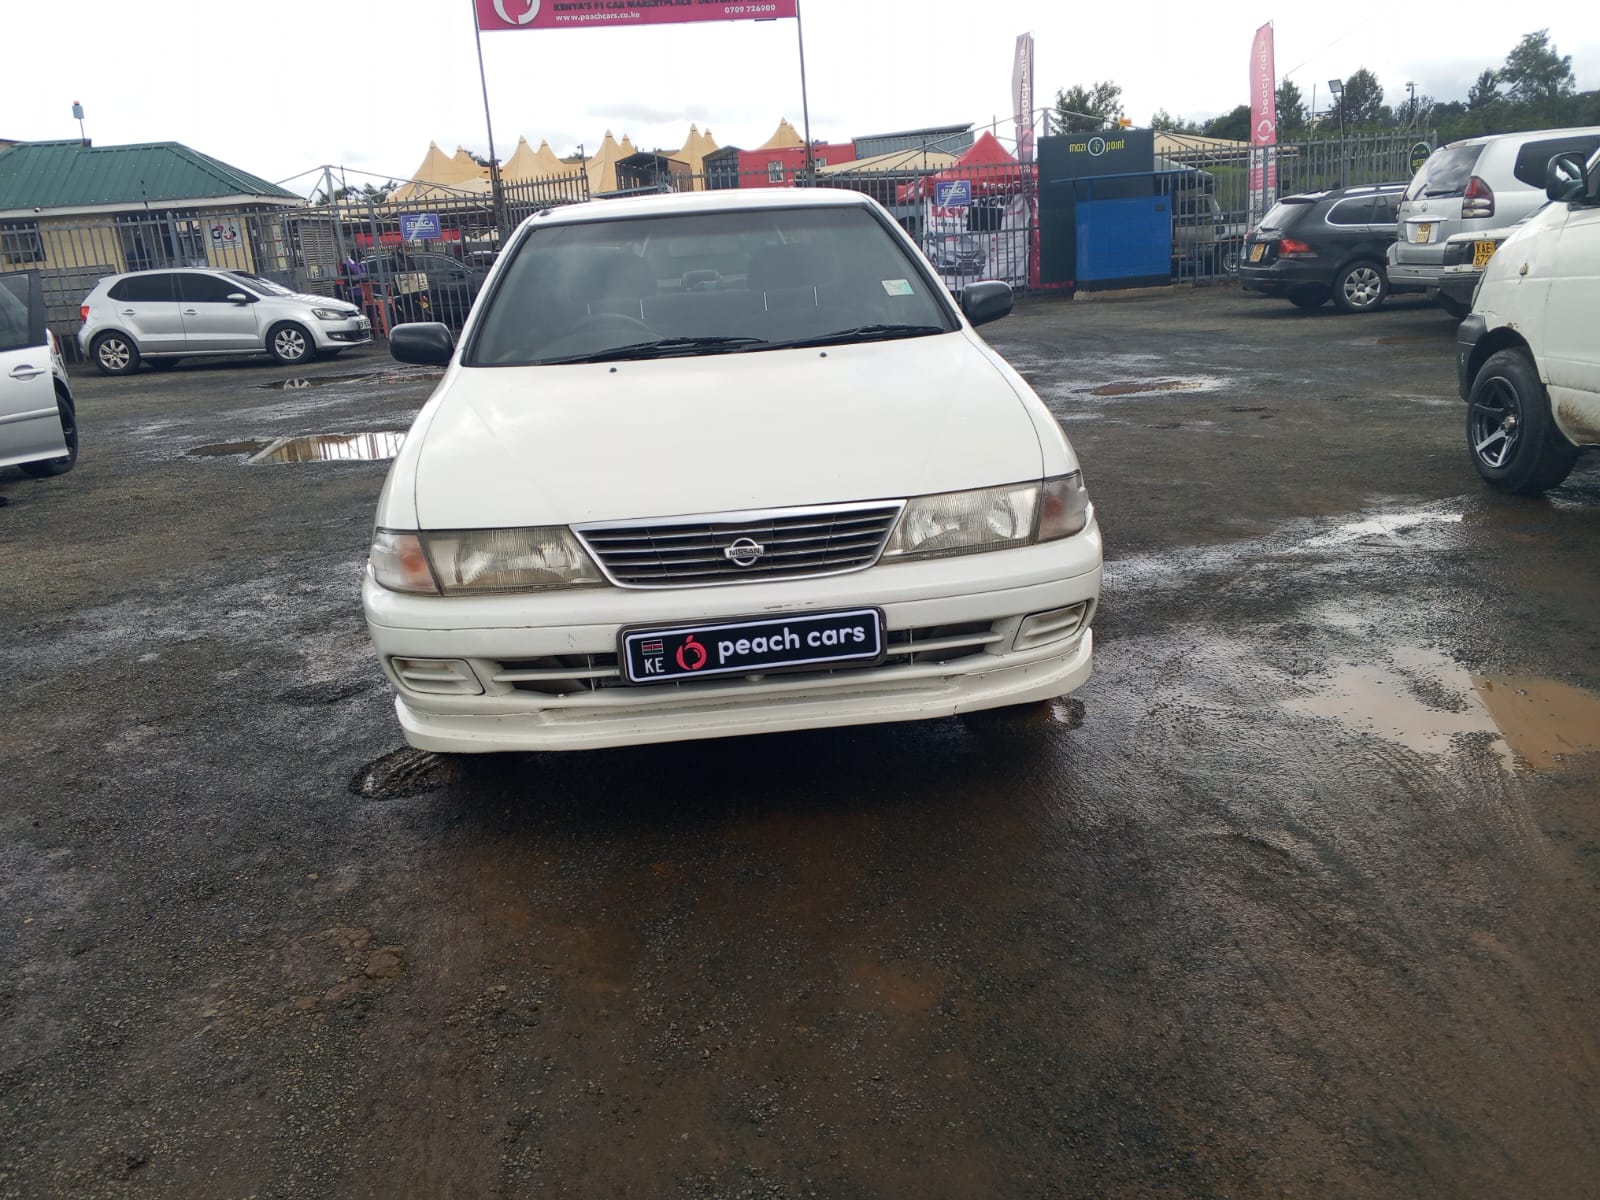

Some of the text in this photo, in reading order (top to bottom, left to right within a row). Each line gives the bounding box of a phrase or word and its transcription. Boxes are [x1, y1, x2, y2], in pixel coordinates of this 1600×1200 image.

[606, 0, 624, 9] CAR
[555, 11, 640, 21] www.peachcars.co.ke
[406, 220, 435, 228] SENCA
[729, 547, 762, 558] NISSAN
[718, 626, 866, 664] peach cars
[644, 657, 666, 674] KE
